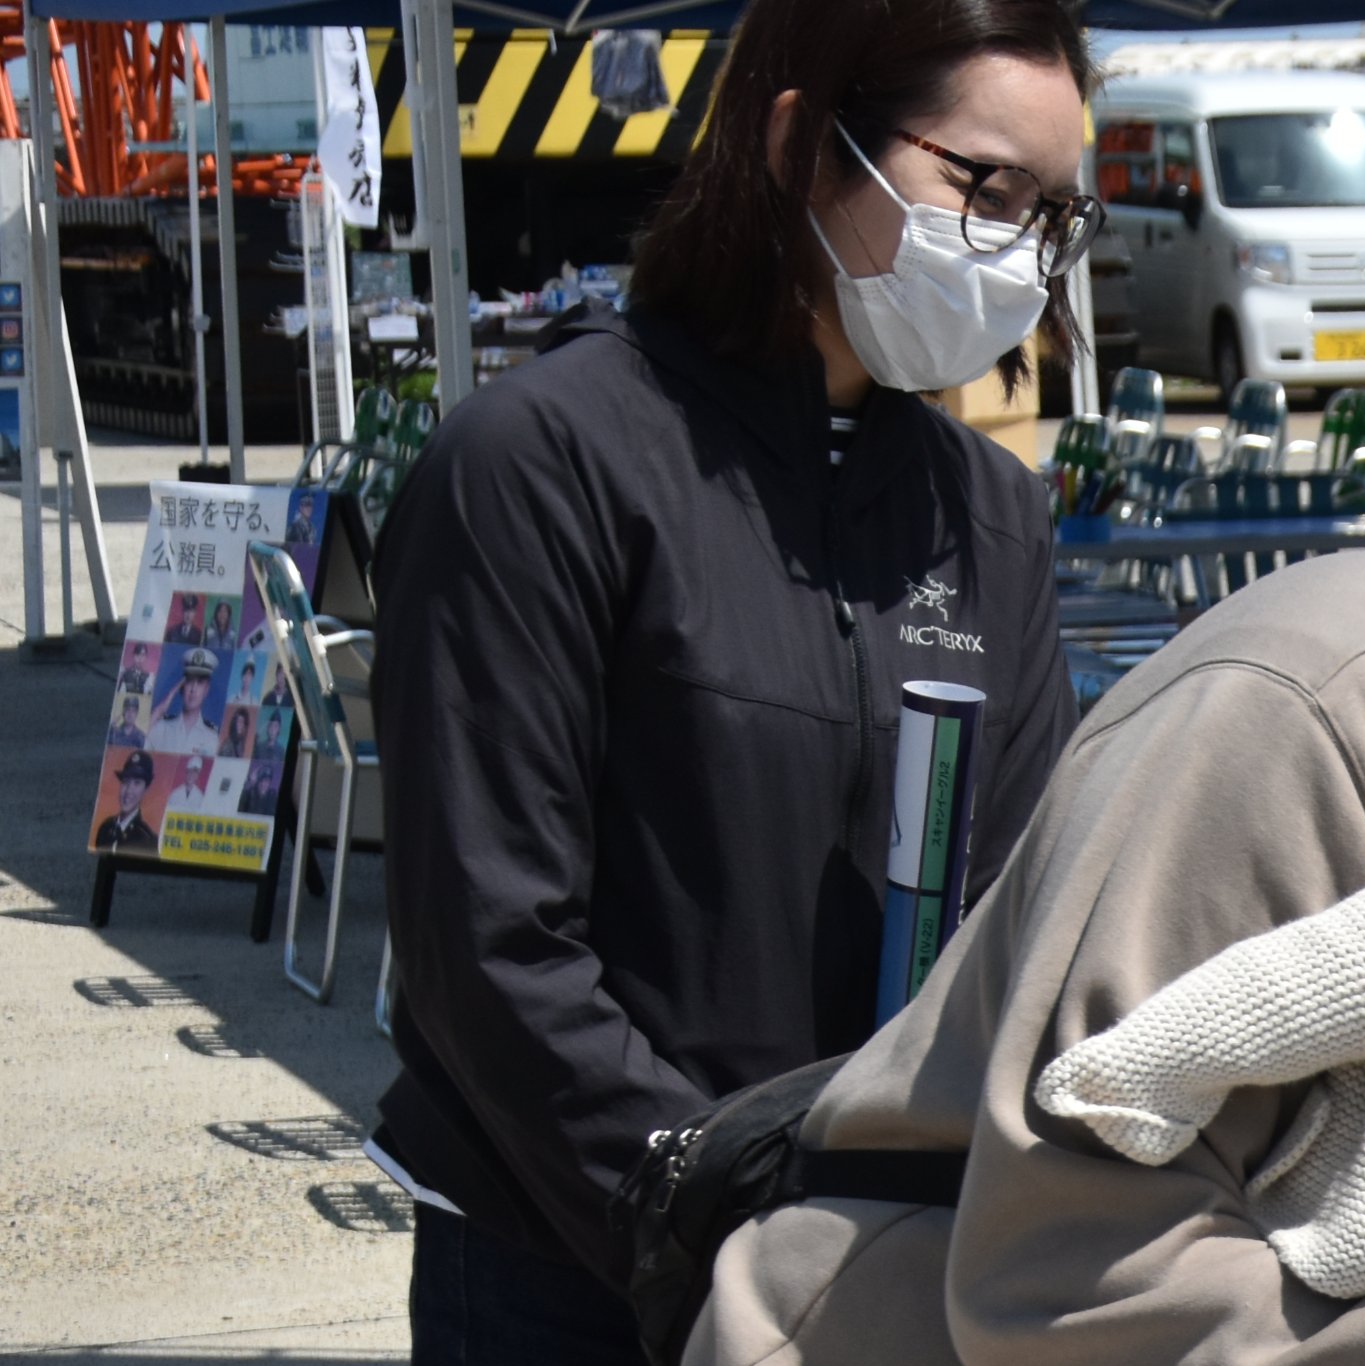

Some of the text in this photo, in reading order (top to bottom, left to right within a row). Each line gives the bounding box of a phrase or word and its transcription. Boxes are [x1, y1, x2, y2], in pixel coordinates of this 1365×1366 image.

[160, 496, 270, 533] 国家を守る、
[150, 540, 225, 576] 公務員。
